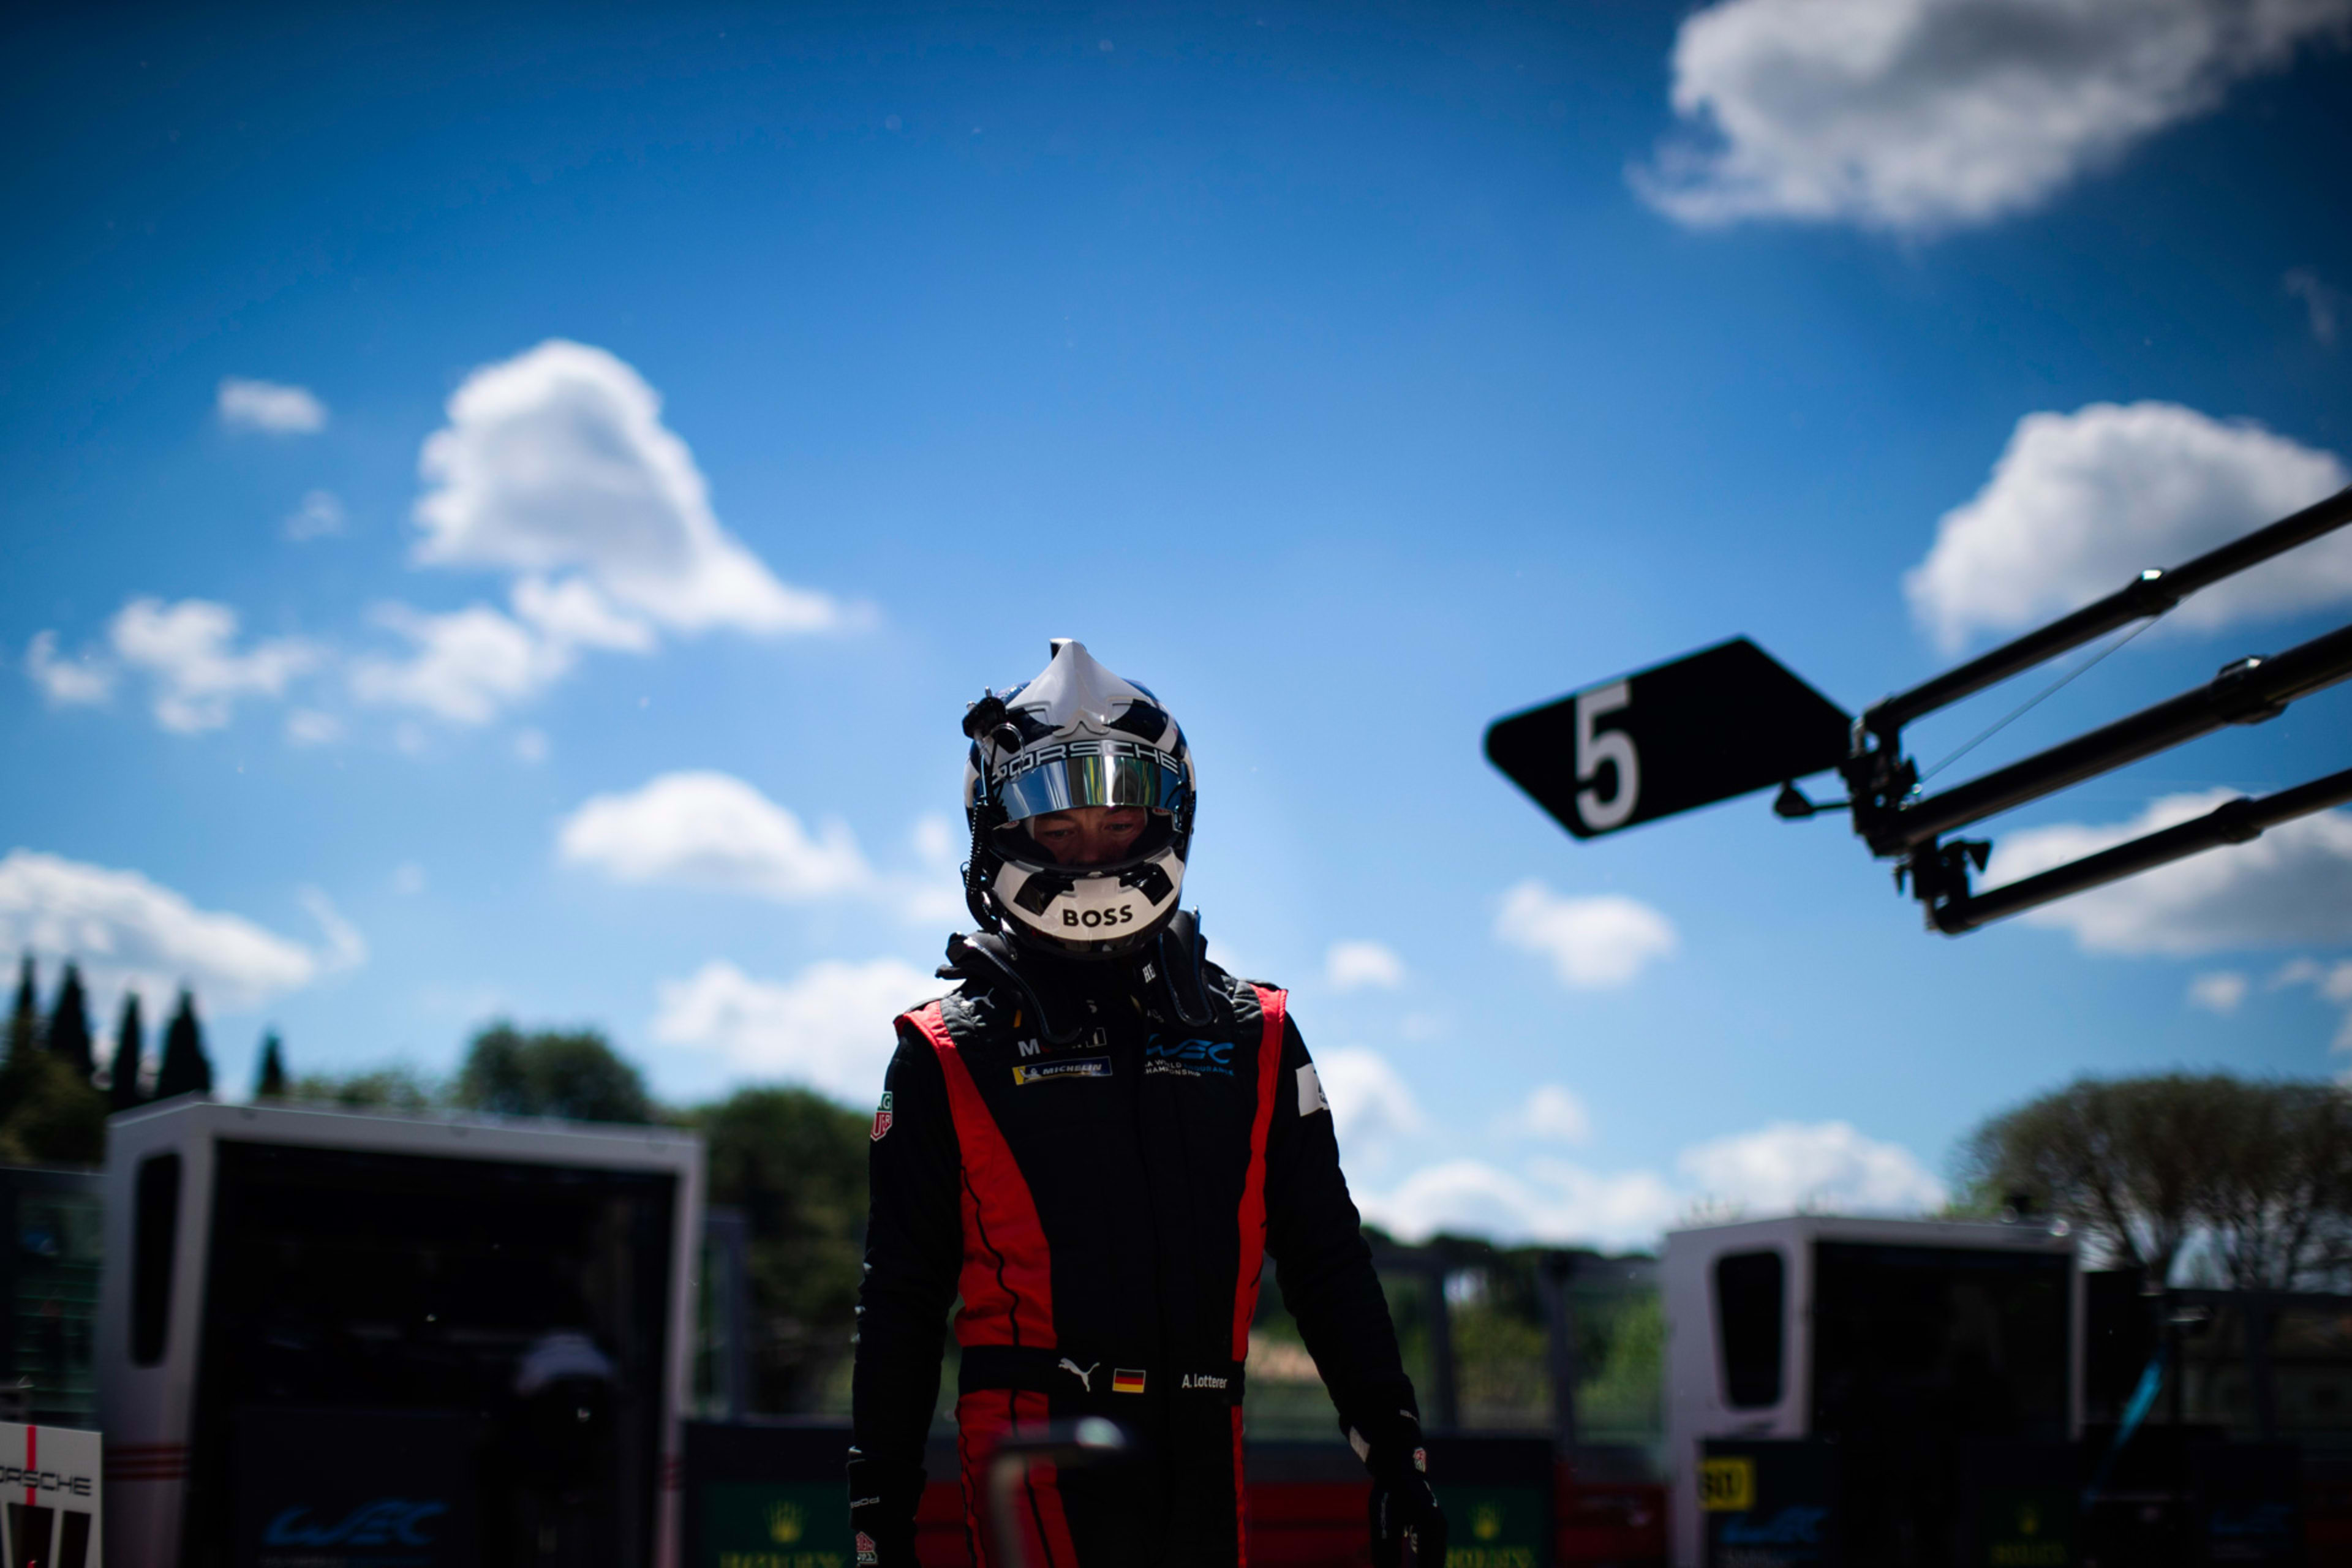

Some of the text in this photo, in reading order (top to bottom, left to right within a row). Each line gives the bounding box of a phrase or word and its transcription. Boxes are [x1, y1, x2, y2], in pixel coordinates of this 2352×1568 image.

[992, 741, 1179, 785] PORSCHE
[1576, 679, 1640, 830] 5
[1063, 905, 1133, 927] BOSS
[1042, 1063, 1102, 1076] MICHELIN
[1193, 1373, 1228, 1390] Lotterer
